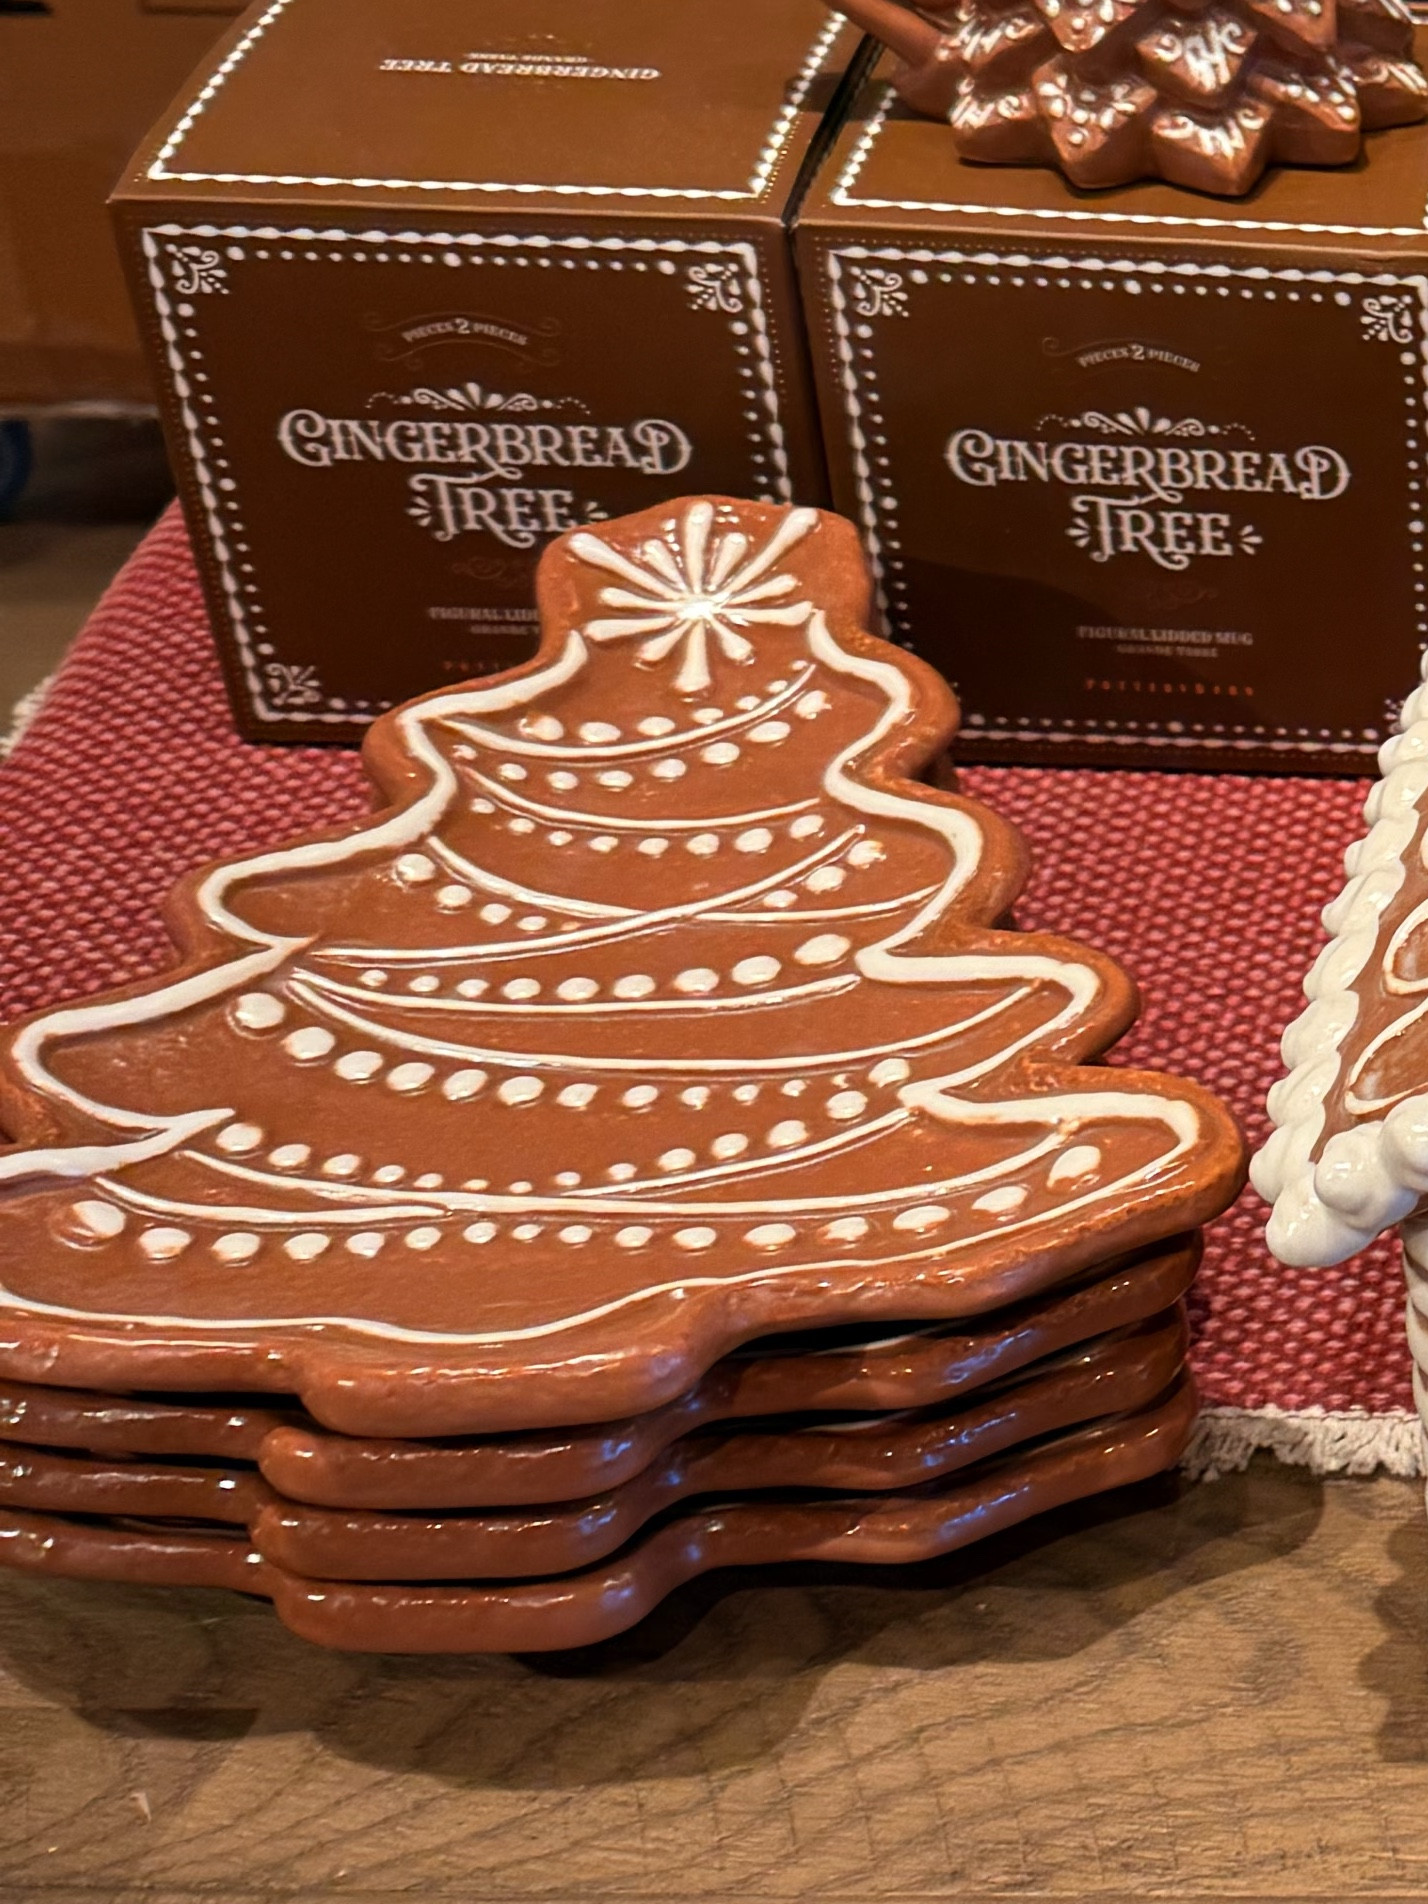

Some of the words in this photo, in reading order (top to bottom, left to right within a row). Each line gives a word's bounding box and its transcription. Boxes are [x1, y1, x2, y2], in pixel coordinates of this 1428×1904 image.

[379, 58, 453, 73] TREE
[459, 62, 661, 80] GINGERBREAD
[455, 317, 471, 335] 2
[1130, 343, 1146, 361] 2
[277, 409, 693, 480] GINGERBREAD
[943, 428, 1351, 503] GINGERBREAD
[408, 473, 577, 548] TREE
[1071, 496, 1233, 571] TREE
